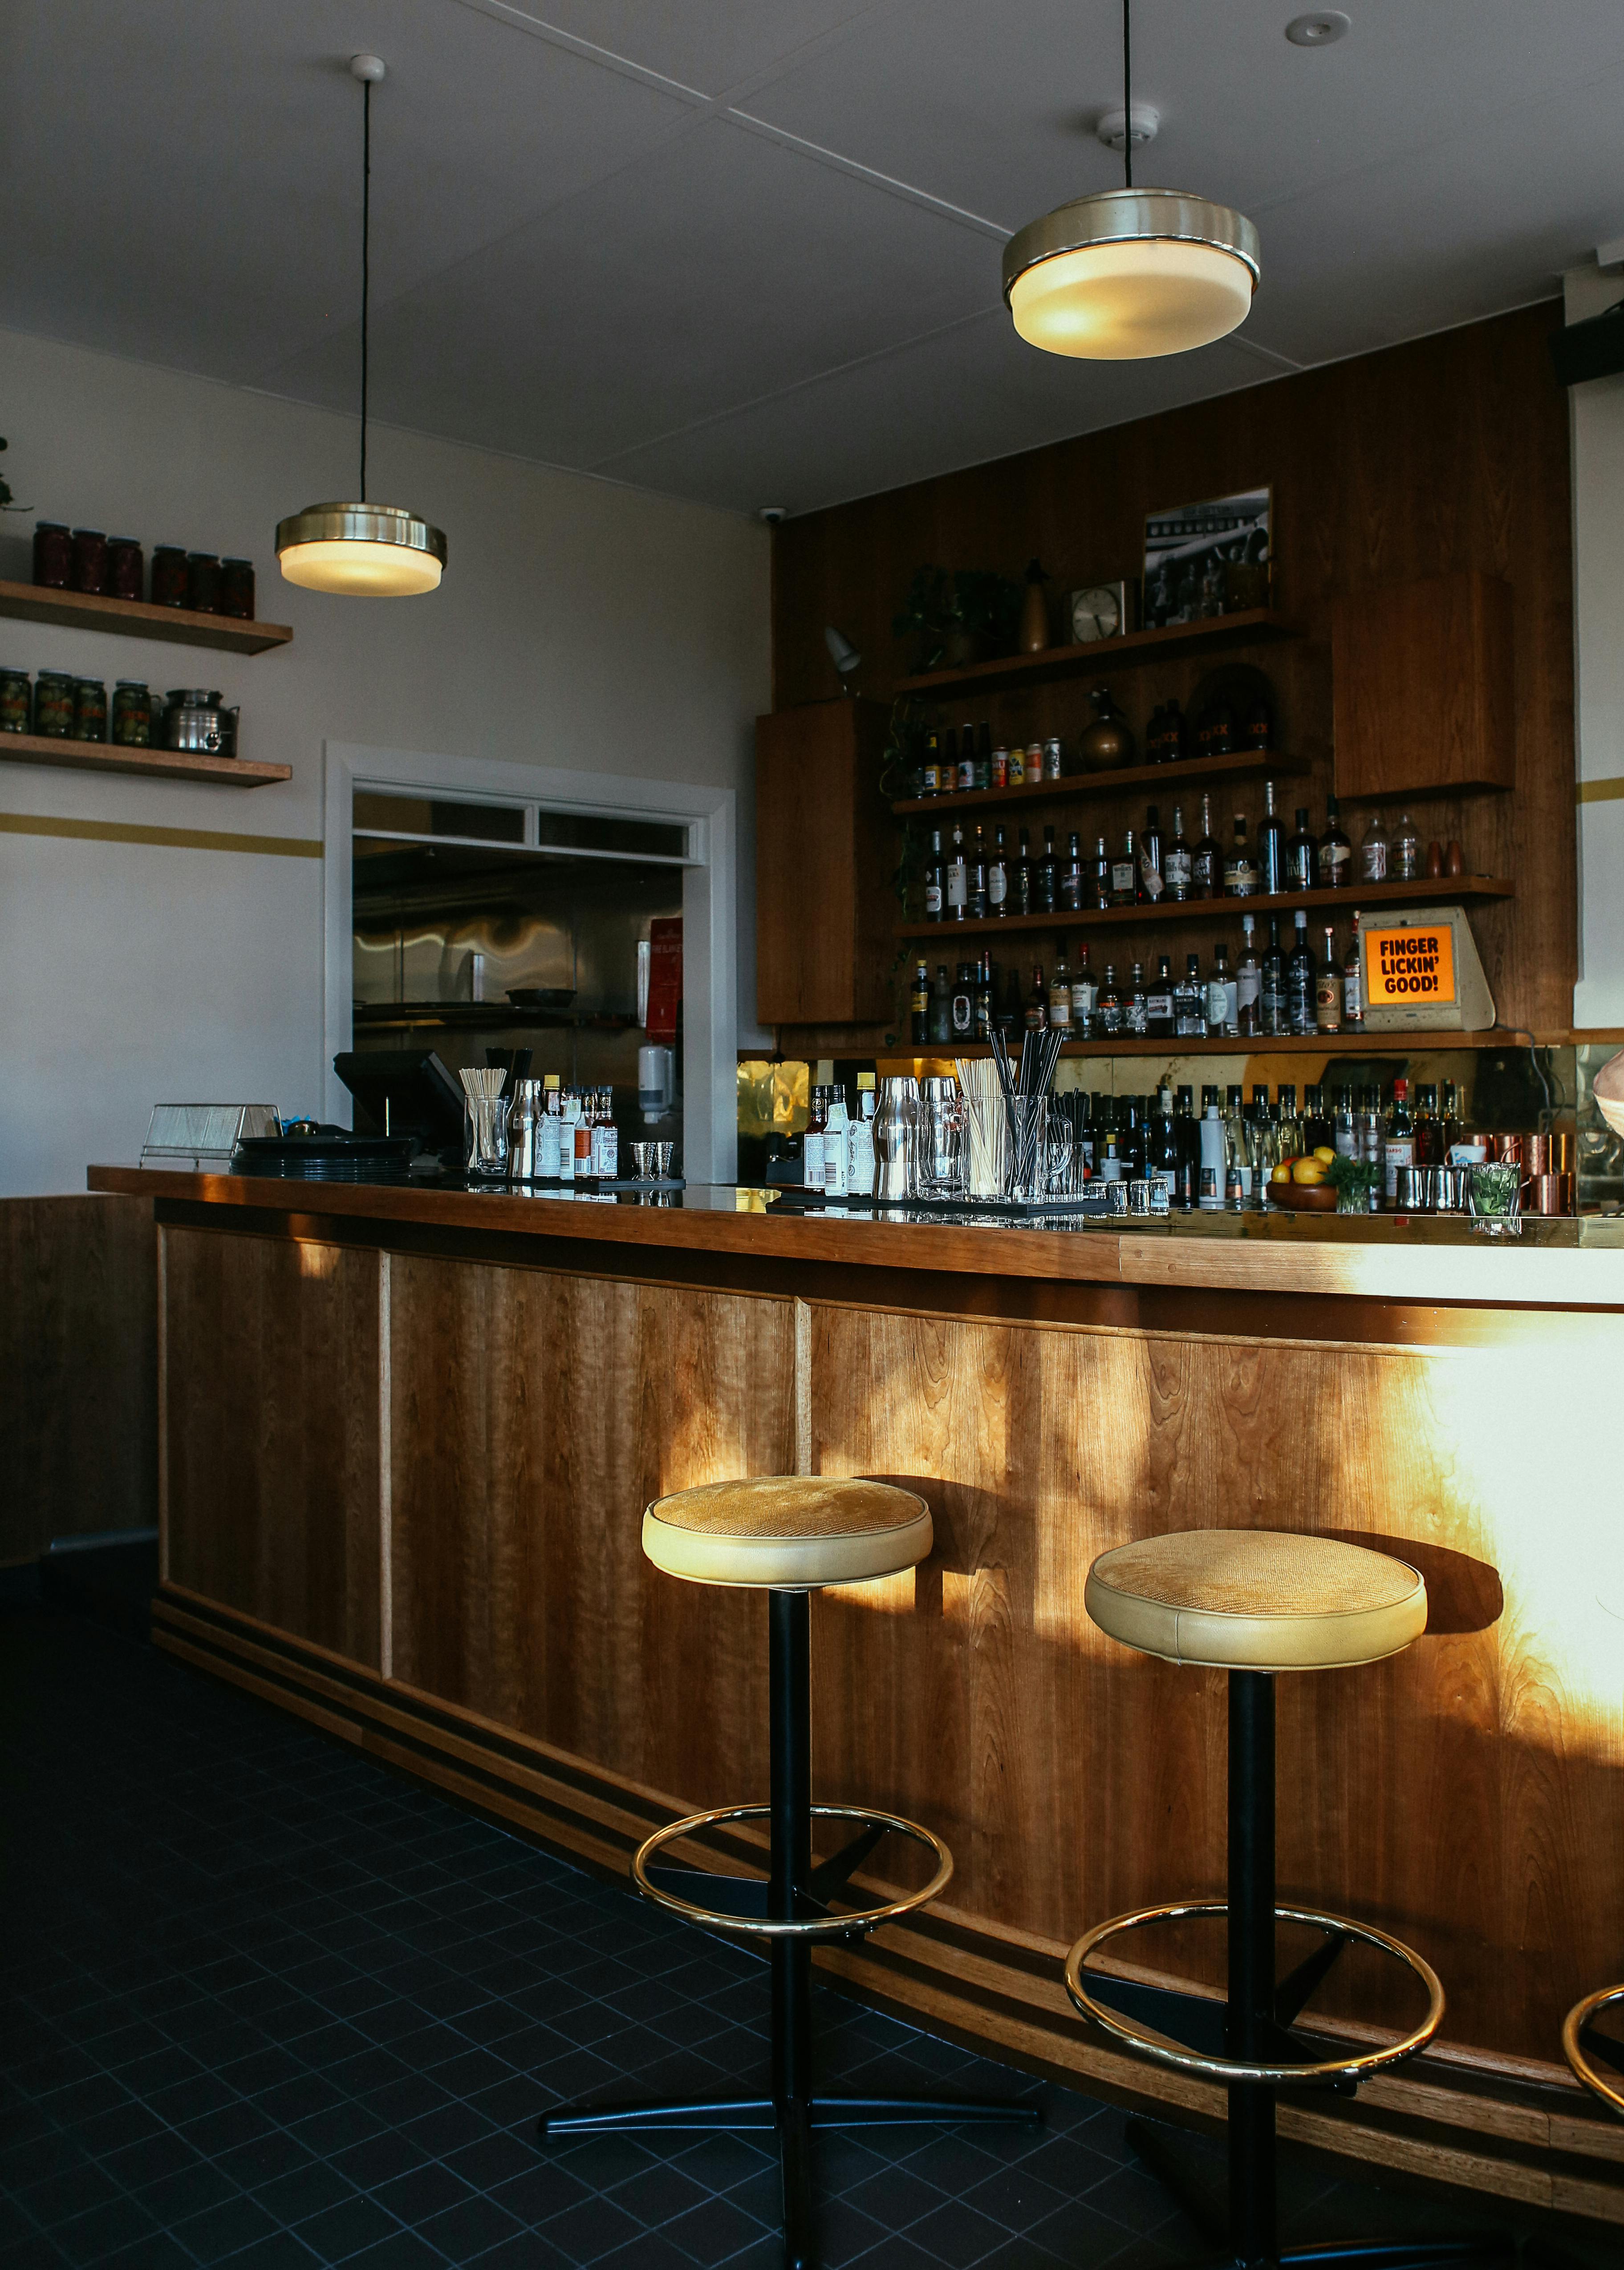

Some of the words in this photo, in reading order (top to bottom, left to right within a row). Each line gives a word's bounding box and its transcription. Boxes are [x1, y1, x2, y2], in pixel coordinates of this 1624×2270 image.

[1380, 938, 1438, 956] FINGER
[1381, 956, 1439, 975] LICKIN'
[1385, 975, 1438, 993] GOOD!
